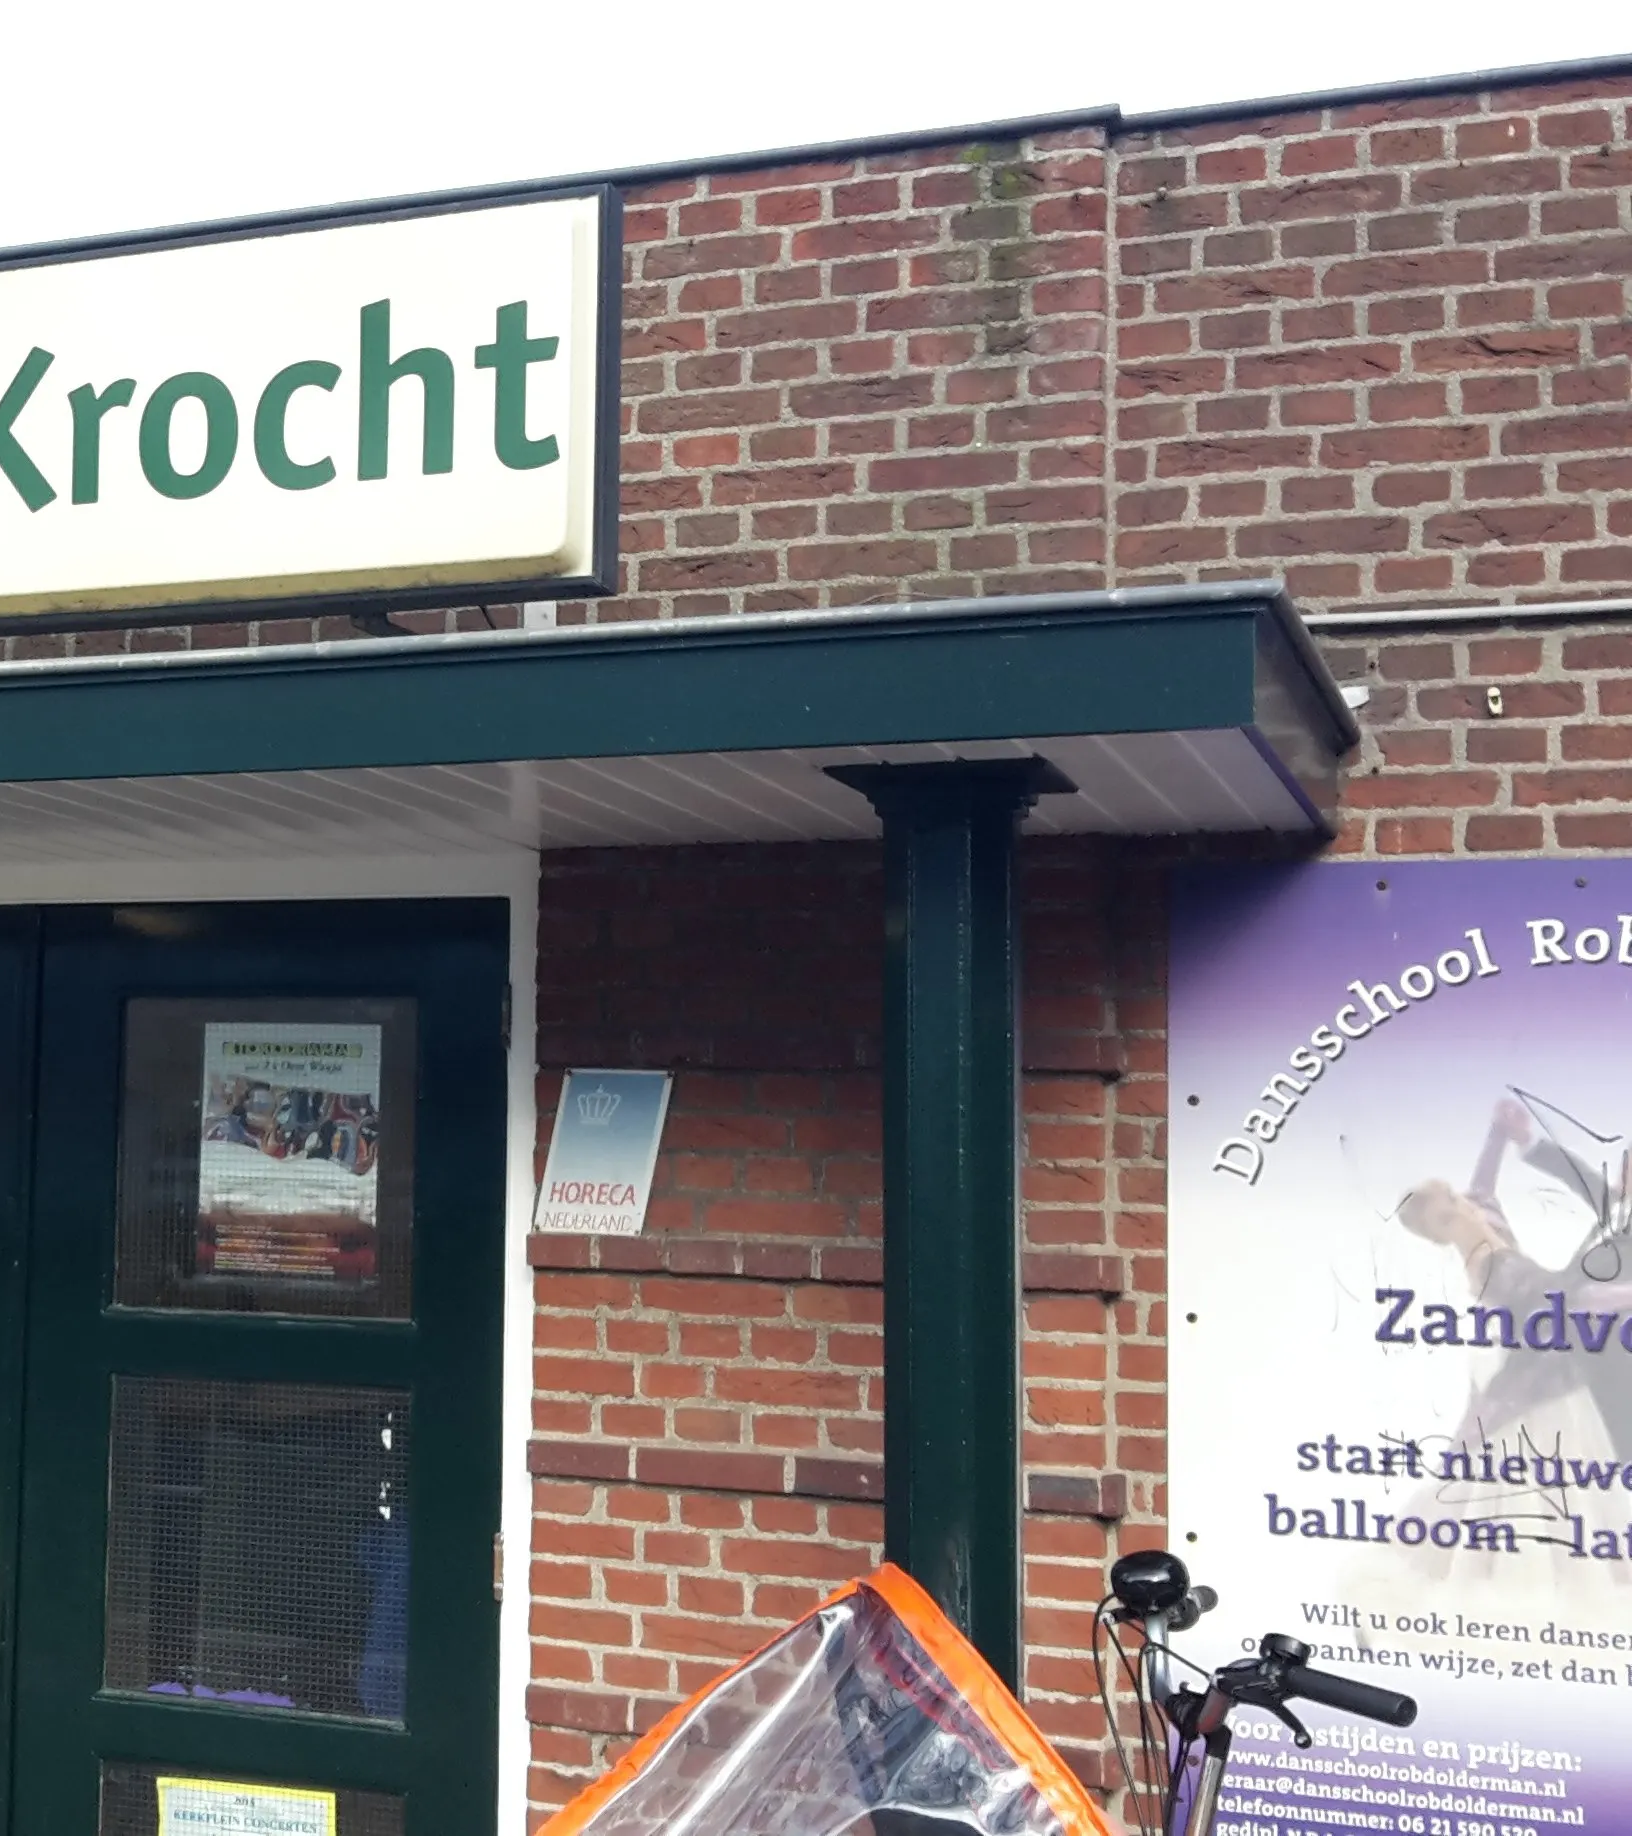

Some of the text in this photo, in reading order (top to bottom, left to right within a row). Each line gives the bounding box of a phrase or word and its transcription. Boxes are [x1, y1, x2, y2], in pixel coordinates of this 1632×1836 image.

[1212, 928, 1499, 1186] Dansschool
[548, 1181, 636, 1206] HORECA
[543, 1211, 634, 1231] NEDERLAND
[1296, 1433, 1423, 1479] start
[1263, 1493, 1520, 1553] ballroom
[1301, 1602, 1361, 1628] Wilt
[1370, 1613, 1386, 1630] u
[1395, 1612, 1447, 1636] ook
[1456, 1614, 1531, 1643] leren
[1419, 1650, 1503, 1679] wijze,
[1510, 1659, 1553, 1680] zet
[1561, 1660, 1617, 1686] dan
[1423, 1738, 1461, 1760] en
[1466, 1740, 1582, 1772] prijzen:
[1217, 1794, 1394, 1830] telefoonnummer:
[1398, 1814, 1425, 1833] 06
[1430, 1816, 1451, 1836] 21
[1221, 1774, 1584, 1825] eraar@dansschoolrobdolderman.nl
